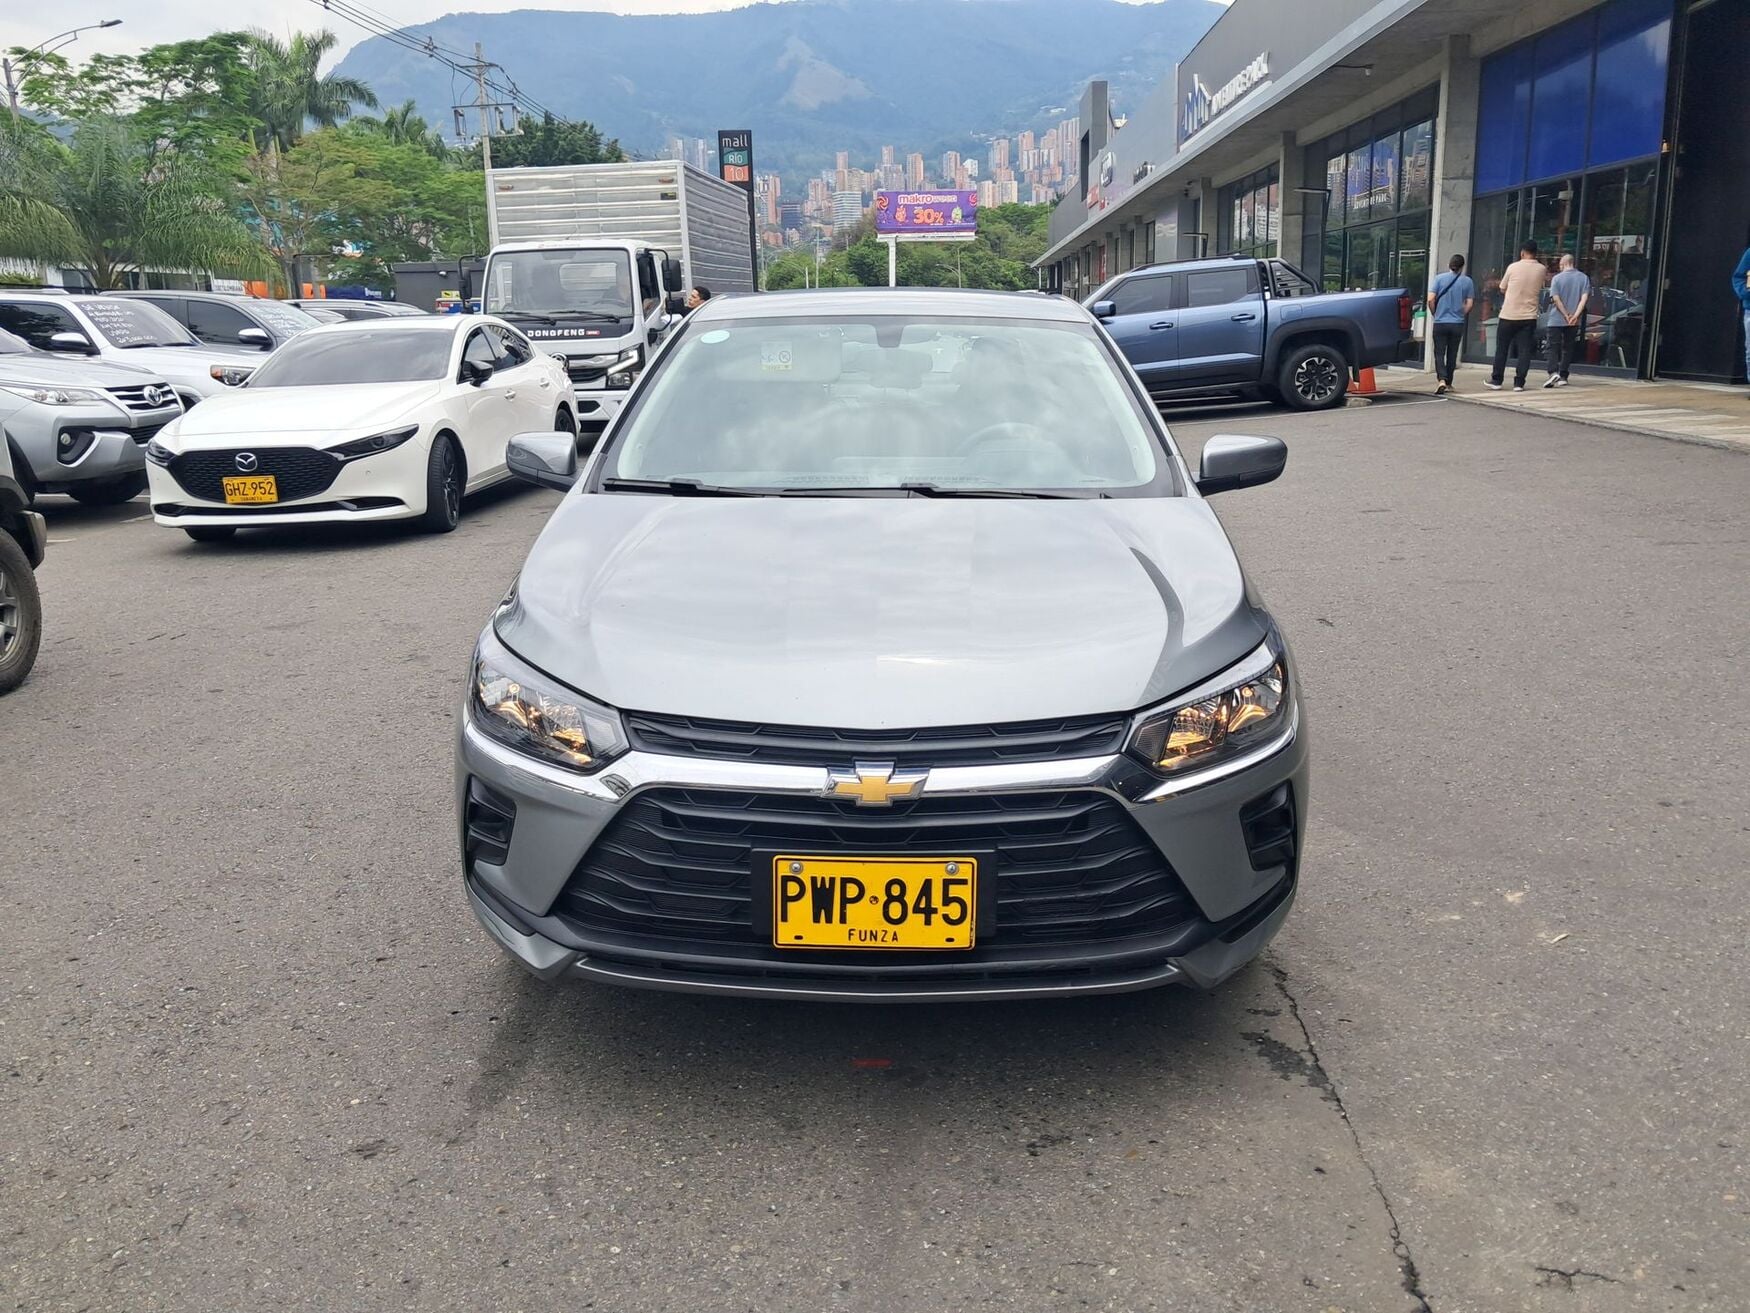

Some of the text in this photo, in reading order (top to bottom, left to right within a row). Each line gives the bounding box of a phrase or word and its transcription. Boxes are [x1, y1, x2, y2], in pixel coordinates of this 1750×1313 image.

[722, 134, 748, 147] mall
[729, 167, 744, 181] 10
[913, 208, 945, 224] 30%
[527, 328, 585, 337] DONGFENG
[848, 928, 899, 943] FUNZA
